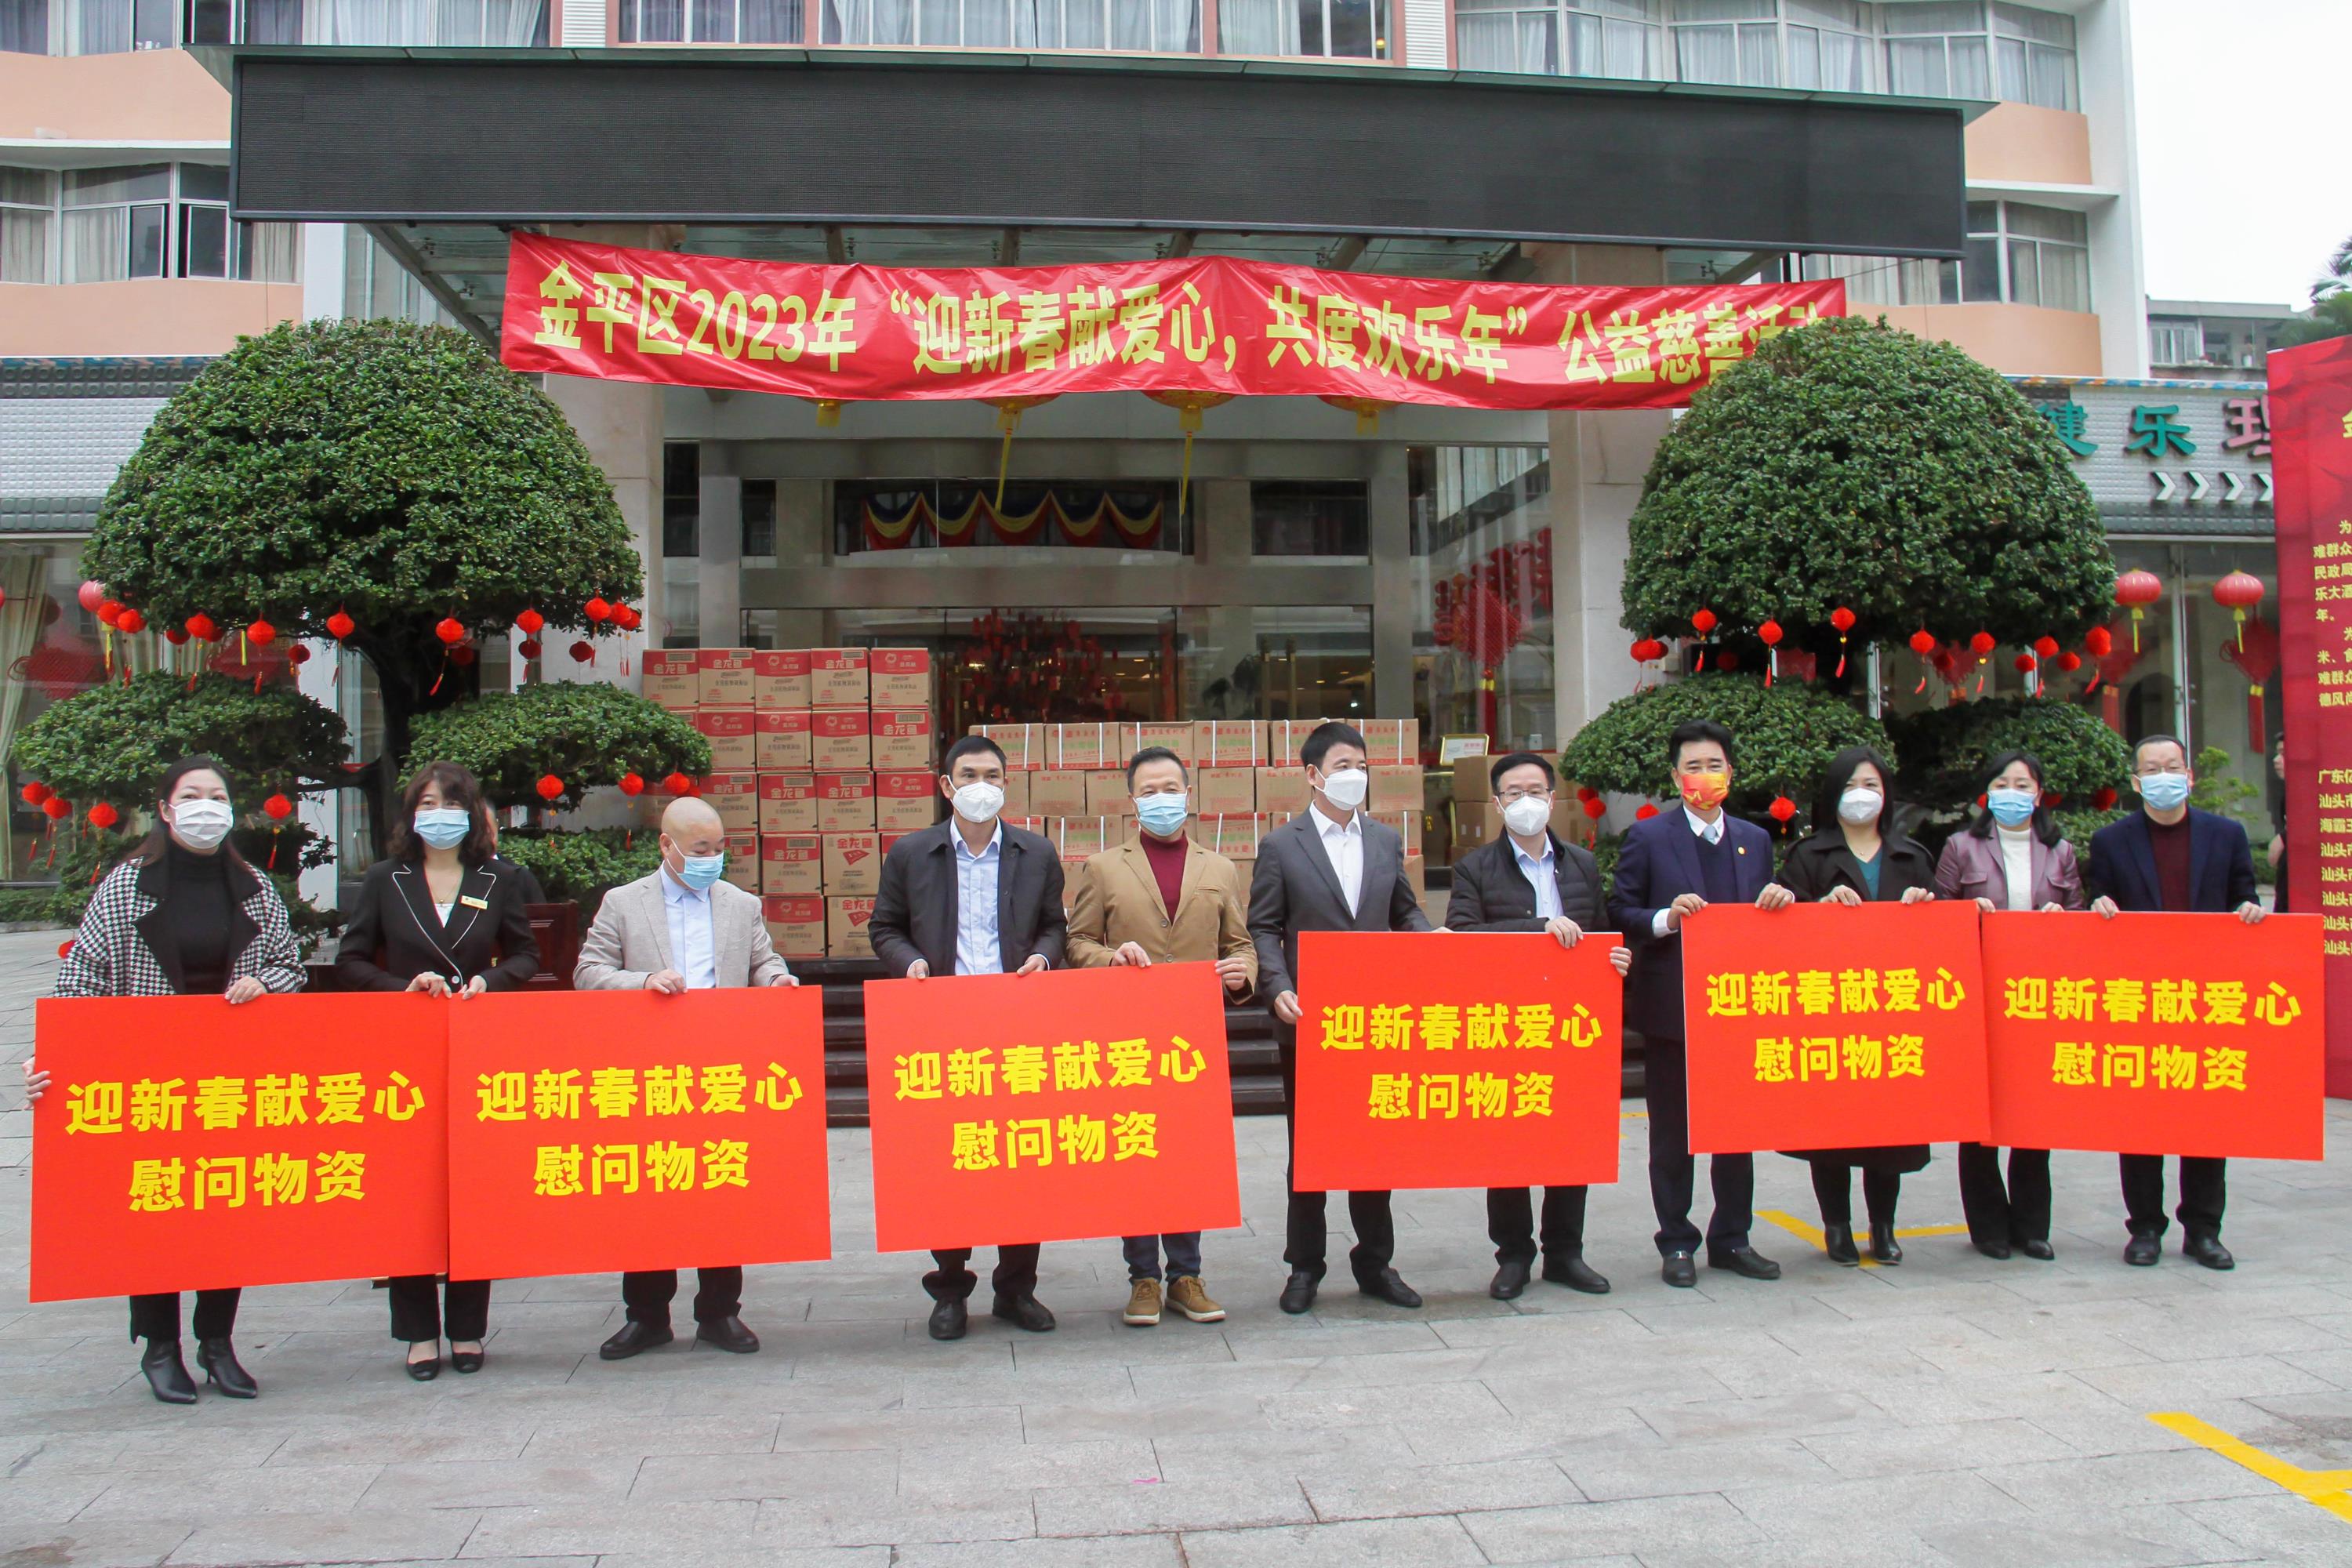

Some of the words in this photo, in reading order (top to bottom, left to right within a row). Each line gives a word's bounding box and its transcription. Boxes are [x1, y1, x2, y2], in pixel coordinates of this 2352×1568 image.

[535, 260, 857, 372] 金平区2023年
[1558, 302, 1825, 384] 公益慈善活
[2339, 520, 2352, 535] 为
[2314, 562, 2352, 580] 民政局
[2315, 608, 2335, 622] 年。
[2324, 915, 2352, 931] 汕头
[2324, 939, 2352, 956] 汕头
[1707, 967, 1965, 1017] 迎新春献爱心
[2005, 977, 2301, 1025] 迎新春献爱心
[1321, 1003, 1602, 1051] 迎新春献爱心
[894, 1036, 1207, 1101] 迎新春献爱心
[1754, 1034, 1925, 1082] 慰问物资
[2053, 1042, 2248, 1091] 慰问物资
[66, 1071, 425, 1134] 迎新春献爱心
[477, 1062, 803, 1121] 迎新春献爱心
[1368, 1072, 1554, 1120] 慰问物资
[952, 1111, 1159, 1171] 慰问物资
[129, 1150, 365, 1211] 慰问物资
[534, 1138, 749, 1196] 慰问物资
